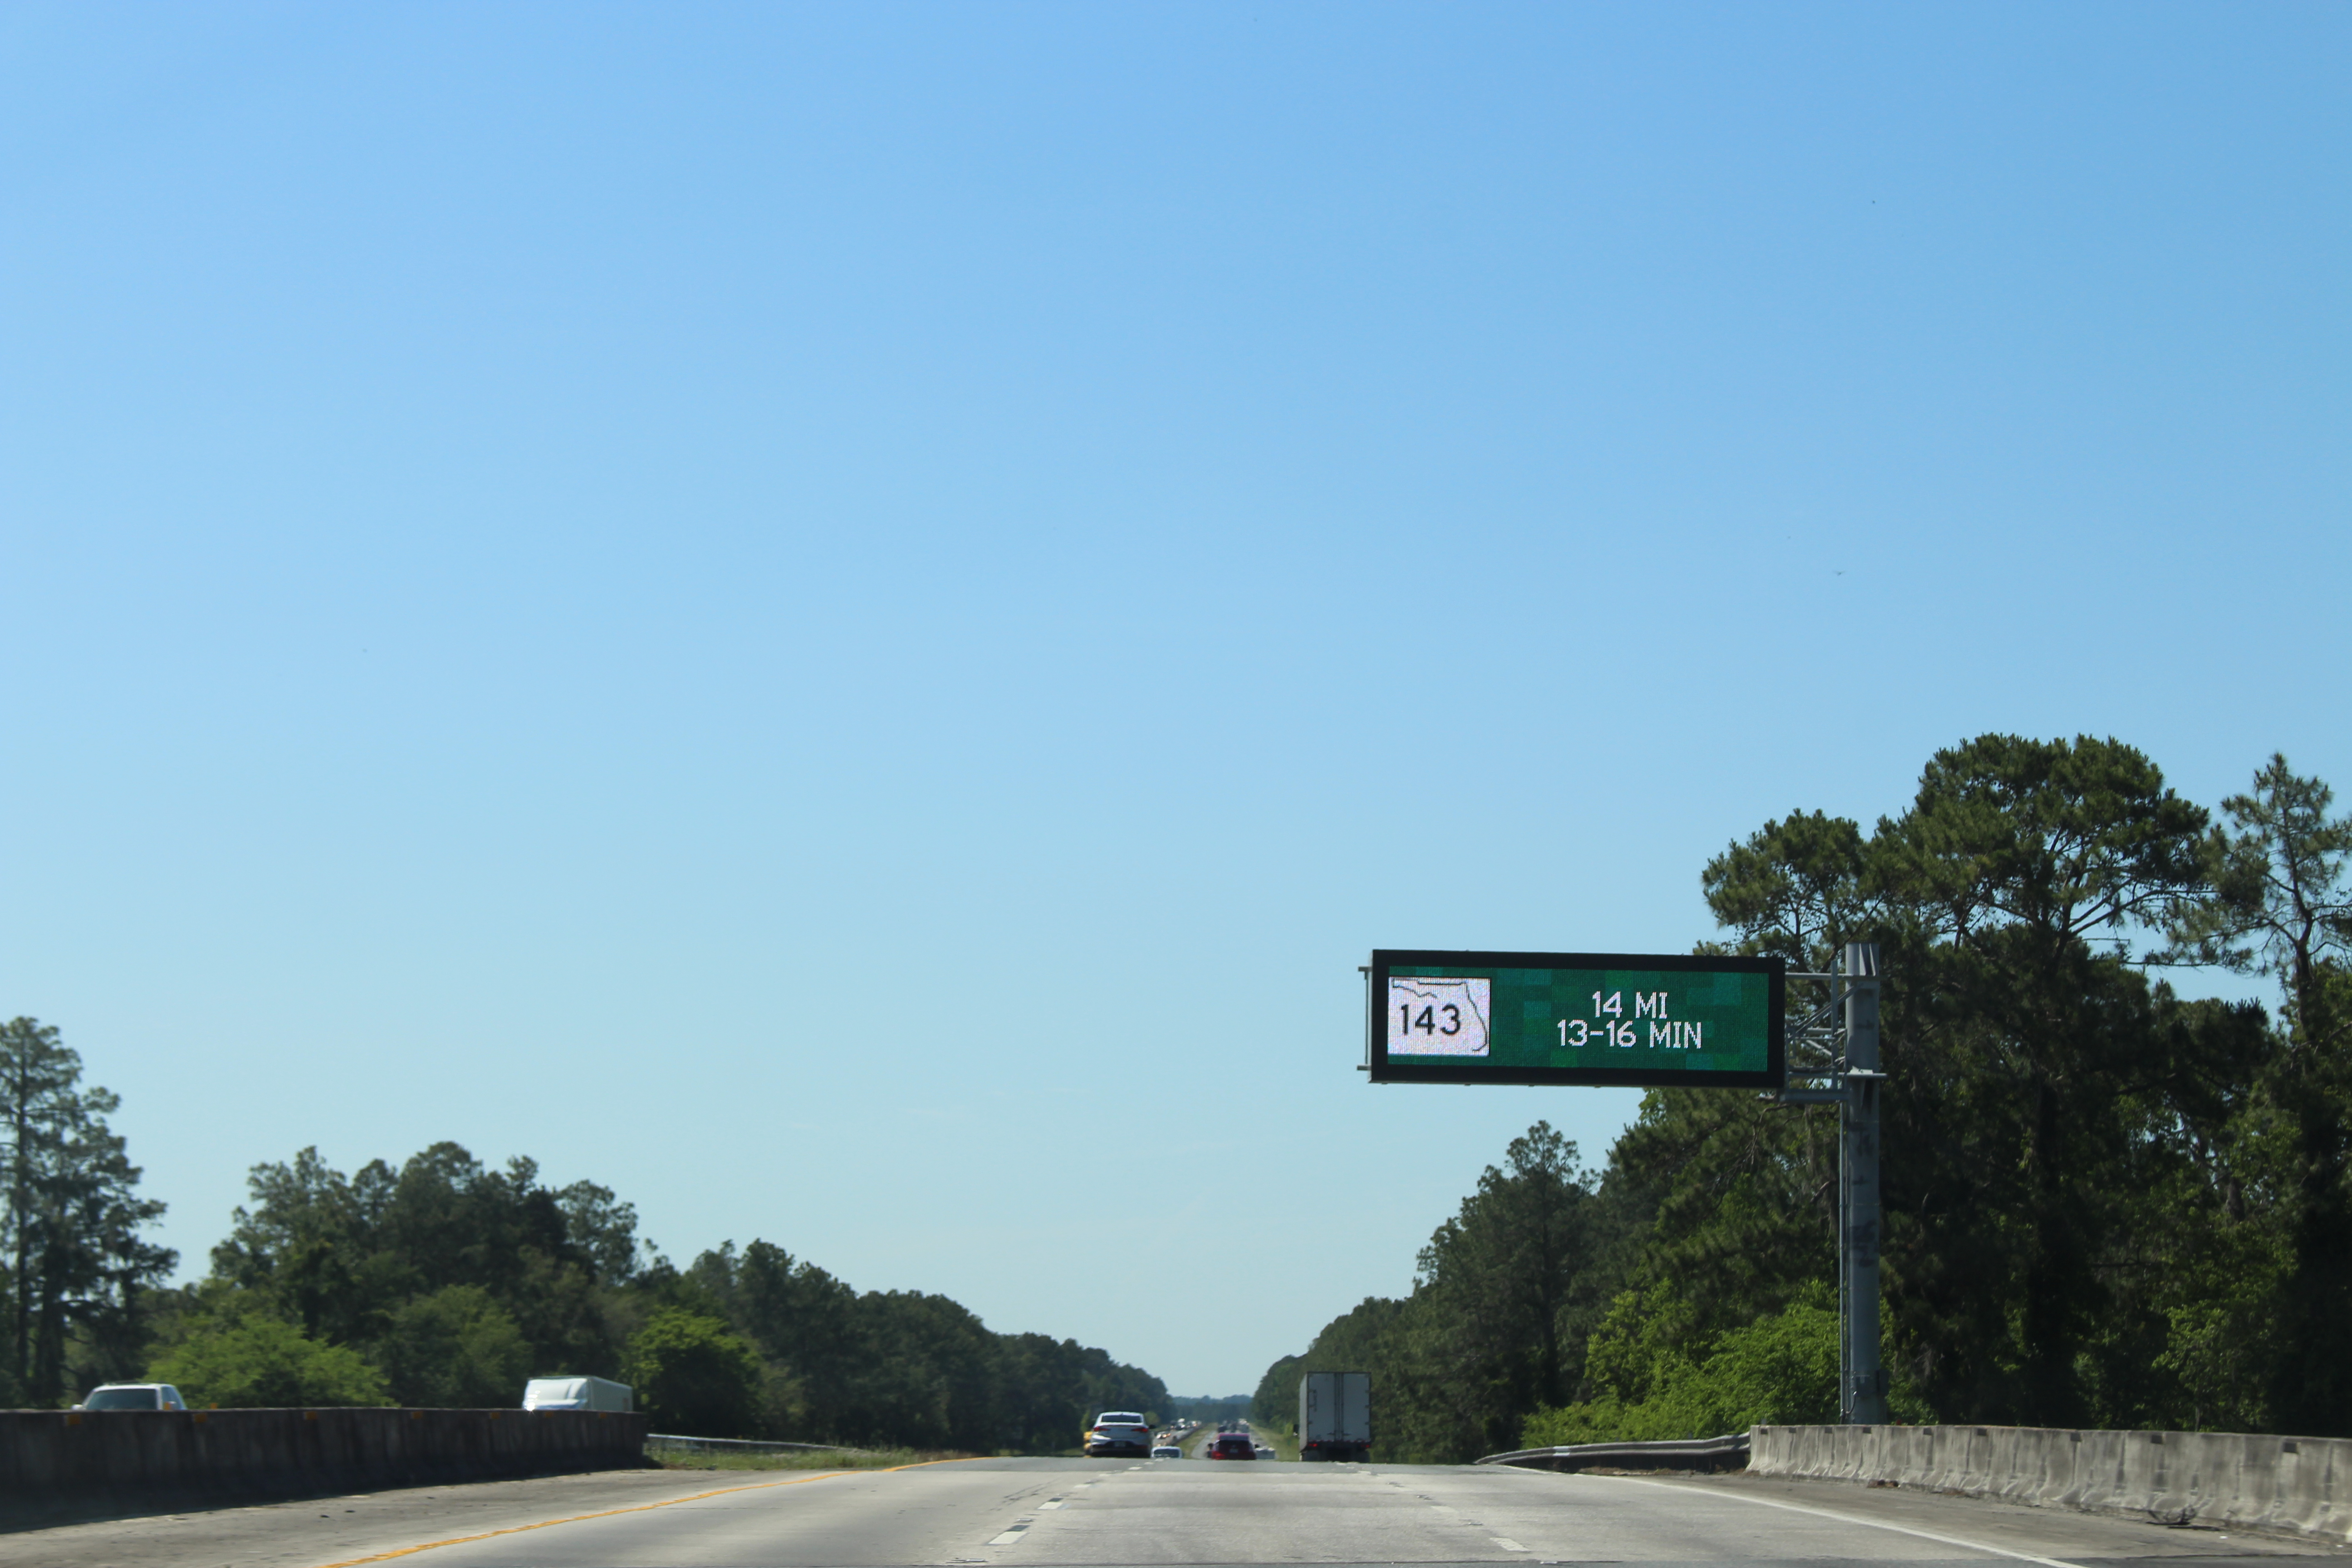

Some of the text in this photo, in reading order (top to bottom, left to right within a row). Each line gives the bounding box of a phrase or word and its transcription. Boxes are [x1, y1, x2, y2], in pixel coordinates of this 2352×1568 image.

[1593, 991, 1667, 1019] 14 MI
[1401, 1004, 1460, 1036] 143
[1558, 1020, 1701, 1048] 13-16 MIN
